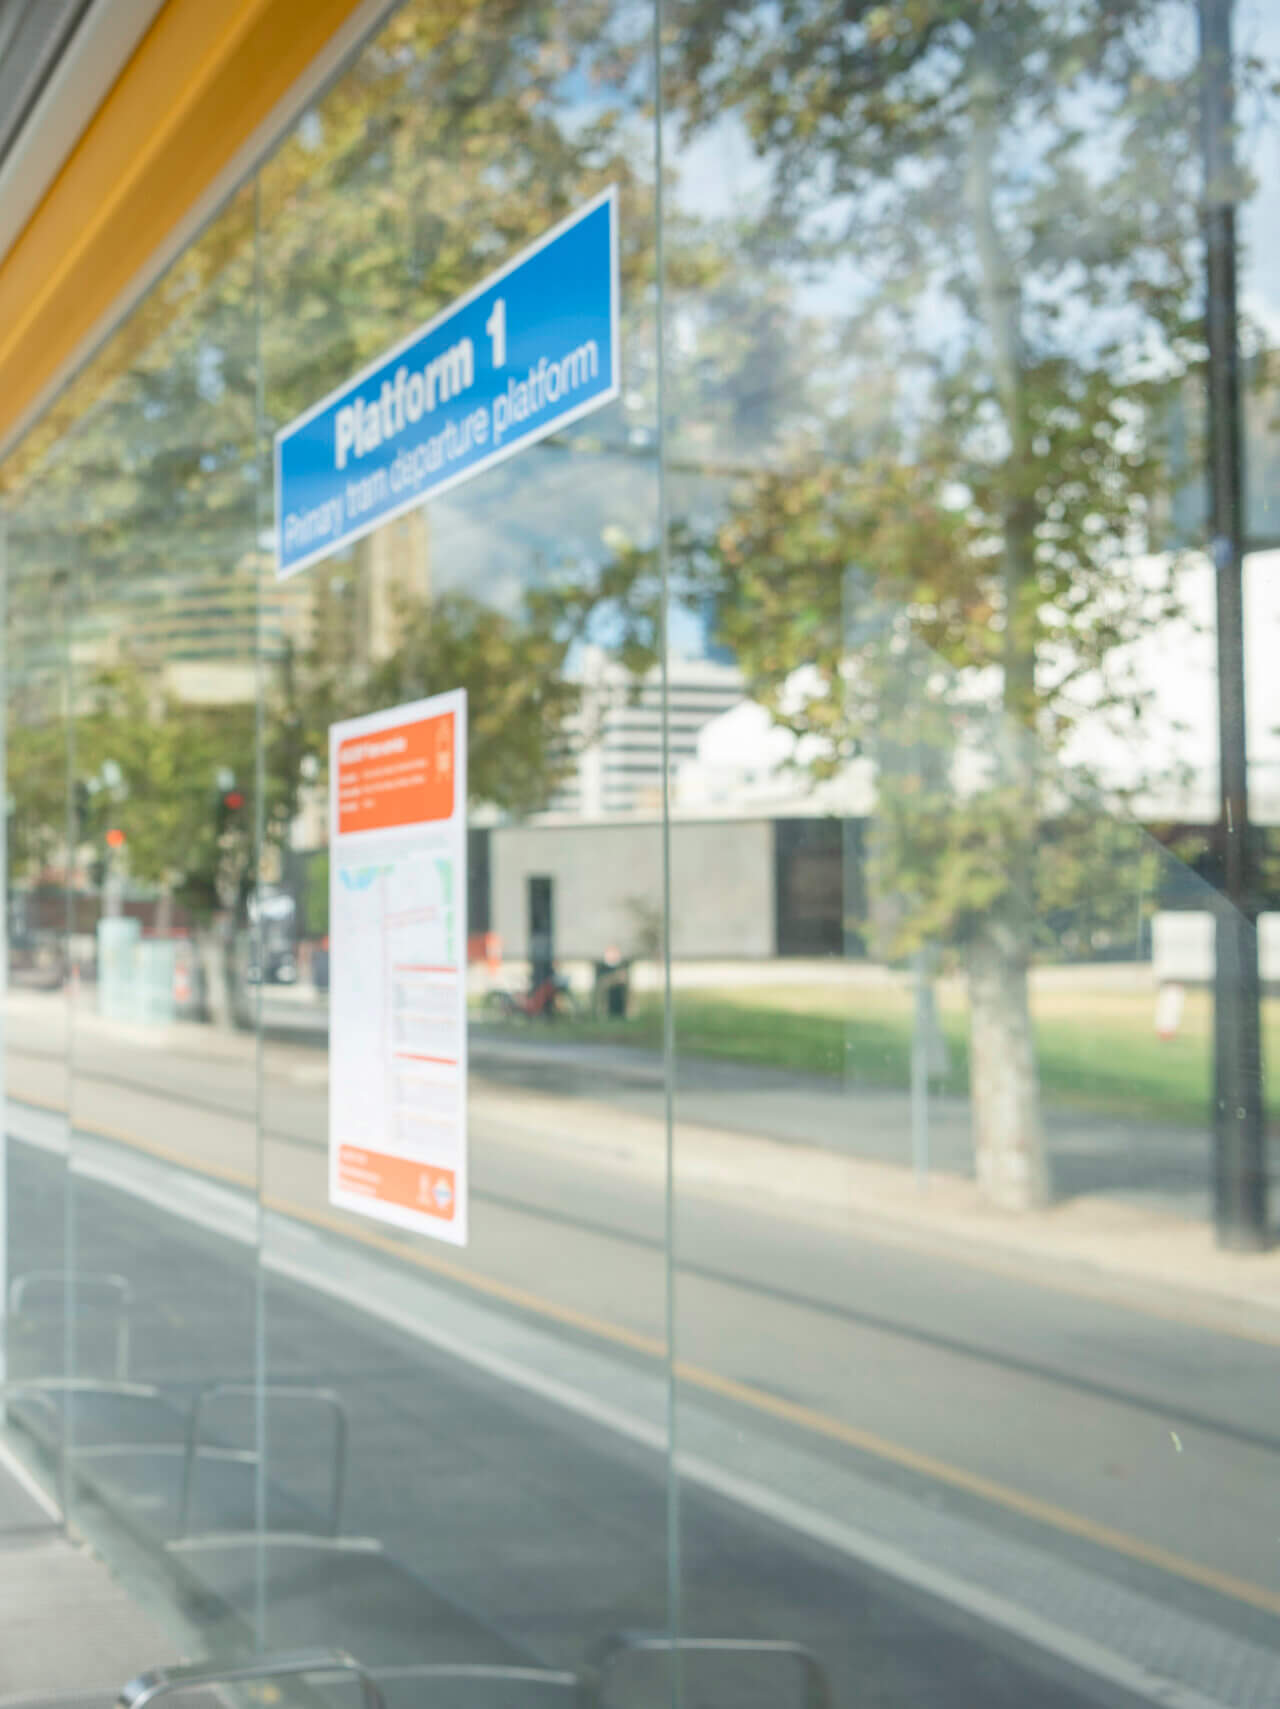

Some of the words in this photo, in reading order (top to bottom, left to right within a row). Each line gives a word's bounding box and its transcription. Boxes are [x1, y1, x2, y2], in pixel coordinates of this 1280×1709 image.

[285, 498, 342, 549] Primary
[347, 470, 389, 517] tram
[390, 407, 488, 491] departure
[493, 339, 599, 442] platform
[336, 337, 474, 468] Platform
[486, 298, 507, 368] 1
